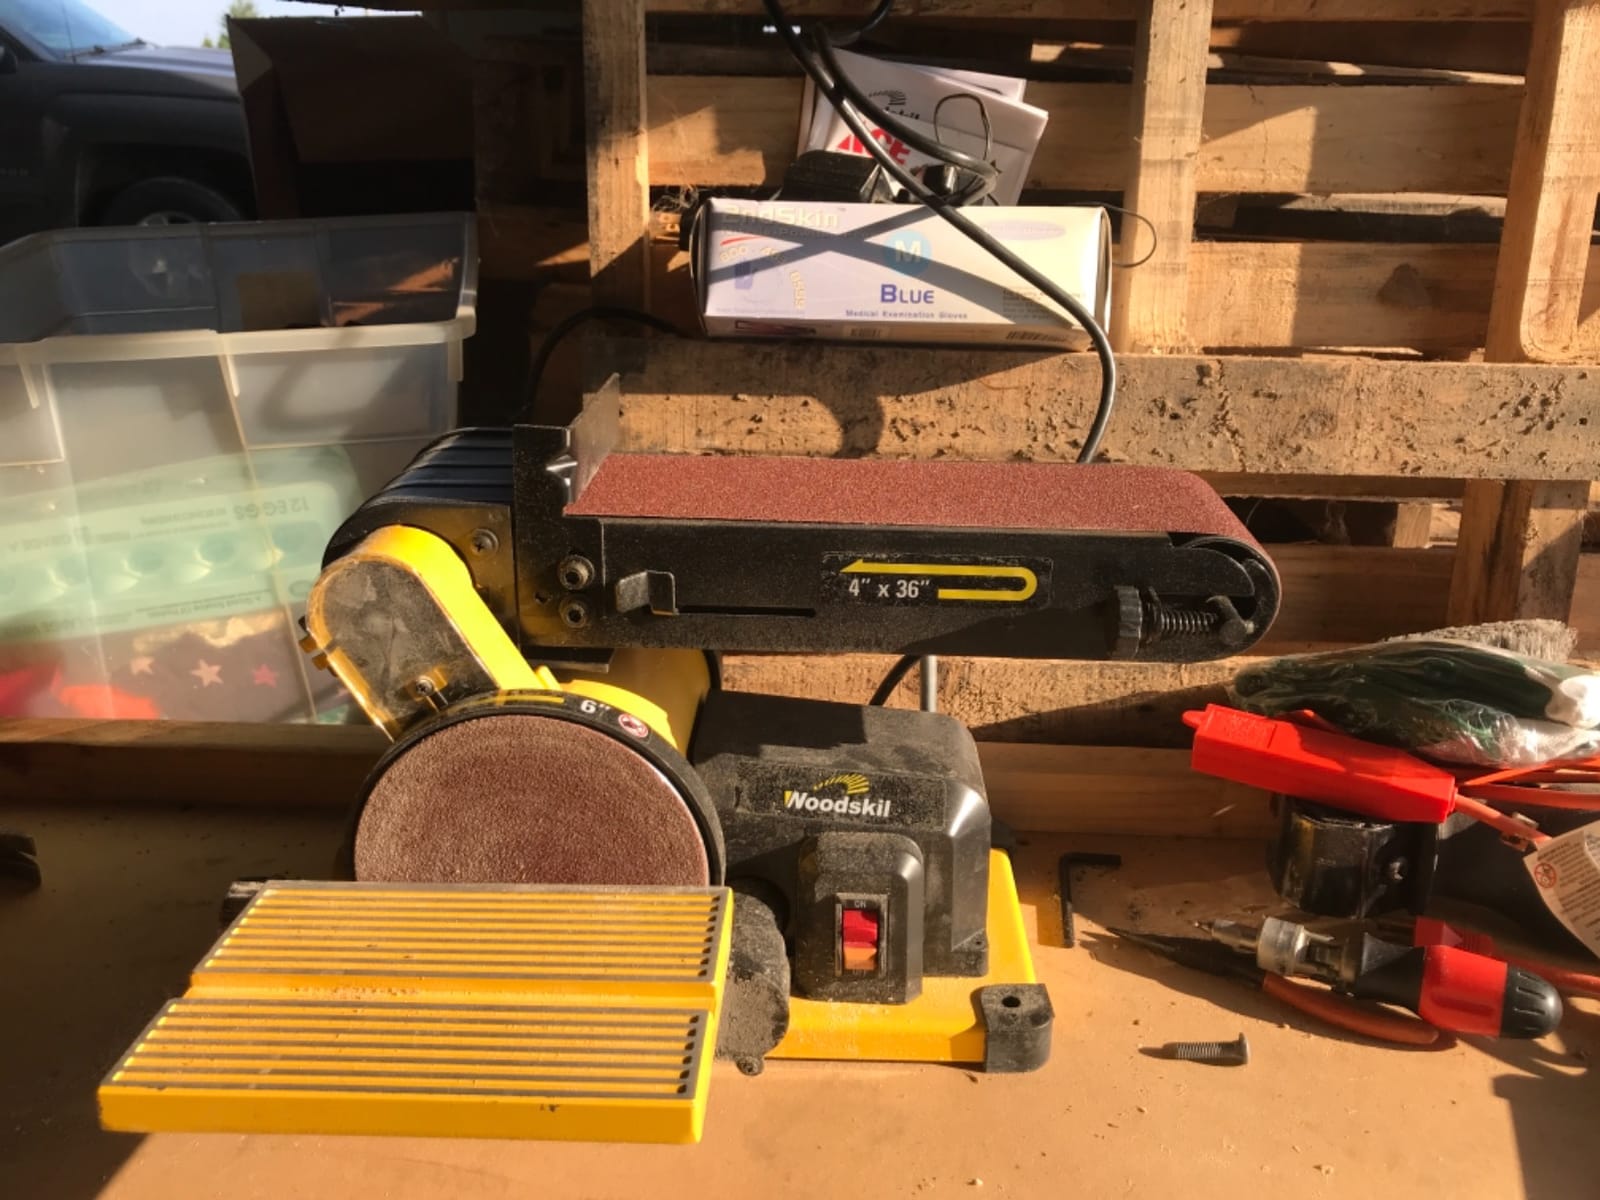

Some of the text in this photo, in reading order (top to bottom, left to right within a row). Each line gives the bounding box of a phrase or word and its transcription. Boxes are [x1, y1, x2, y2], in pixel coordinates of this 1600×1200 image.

[895, 239, 921, 262] M
[880, 283, 935, 304] BLUE
[845, 309, 968, 319] Medical Examination Gloves
[895, 579, 930, 599] 36"
[784, 790, 891, 818] Woodskil
